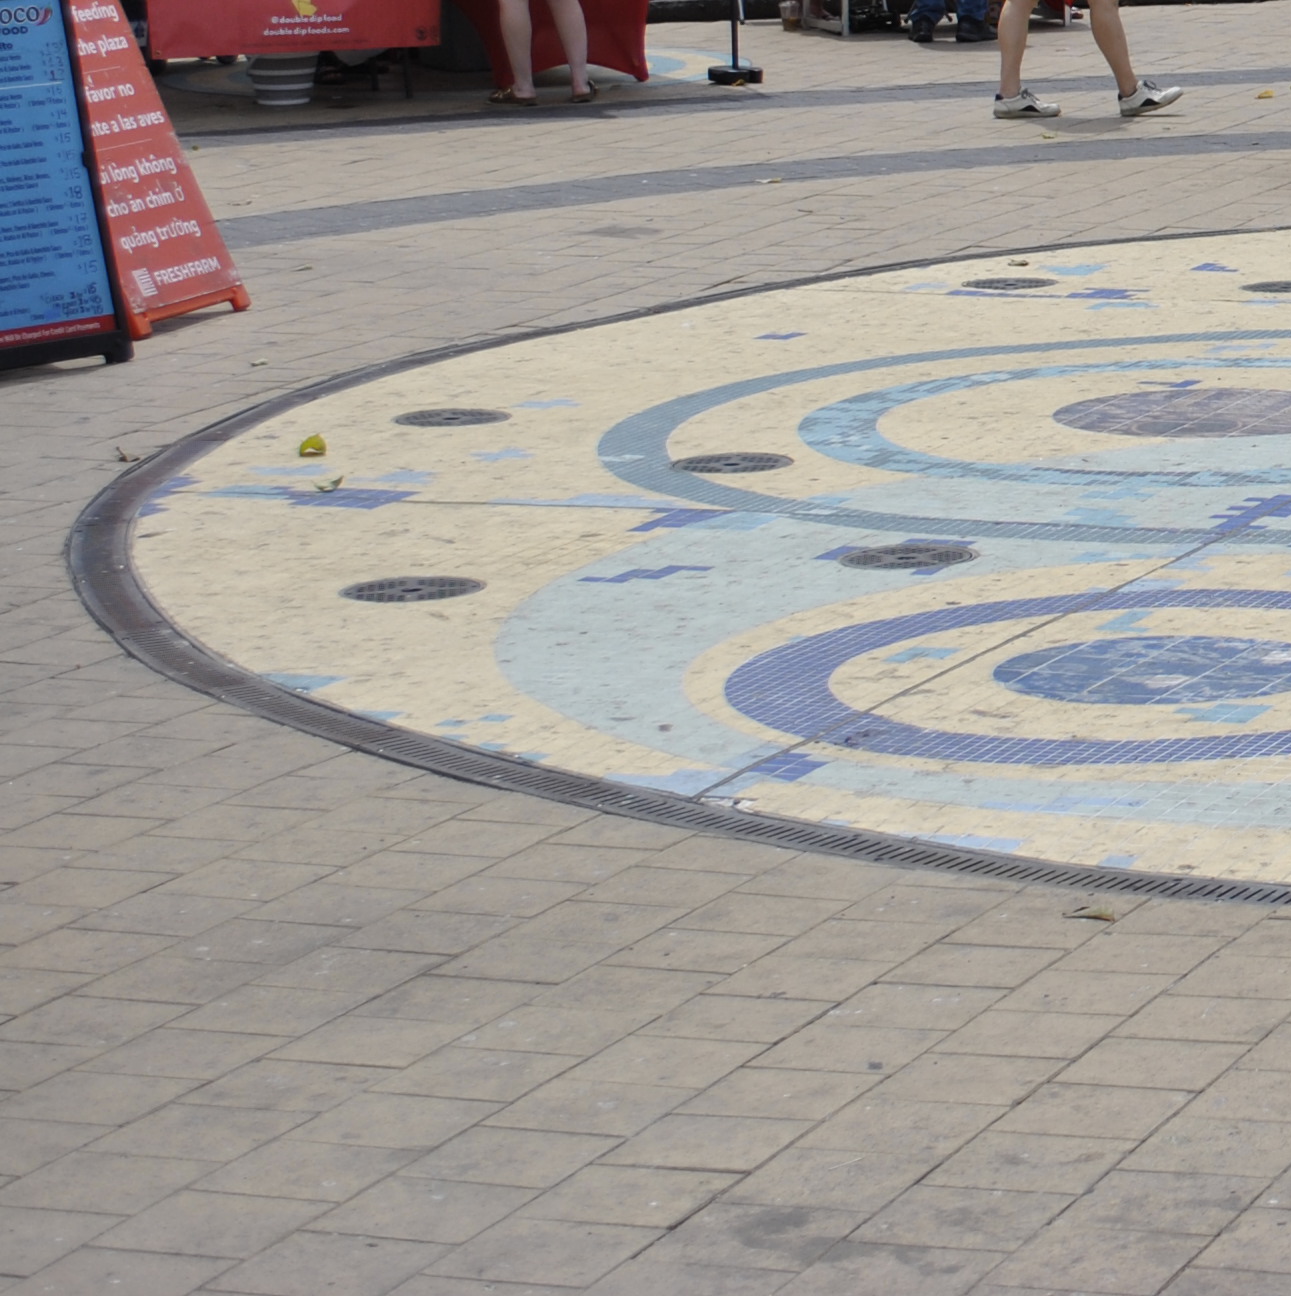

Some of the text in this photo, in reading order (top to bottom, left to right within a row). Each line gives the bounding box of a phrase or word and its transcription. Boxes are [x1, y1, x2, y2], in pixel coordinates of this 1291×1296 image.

[71, 1, 119, 22] feeding
[0, 26, 29, 36] OOD
[77, 35, 129, 57] the plaza
[85, 83, 135, 103] favor no
[110, 119, 120, 133] a
[118, 114, 138, 131] las
[137, 110, 165, 127] aves
[109, 162, 139, 184] lòng
[135, 154, 177, 175] không
[106, 196, 130, 218] cho
[145, 187, 175, 209] chim
[153, 256, 221, 286] FRESHFARM
